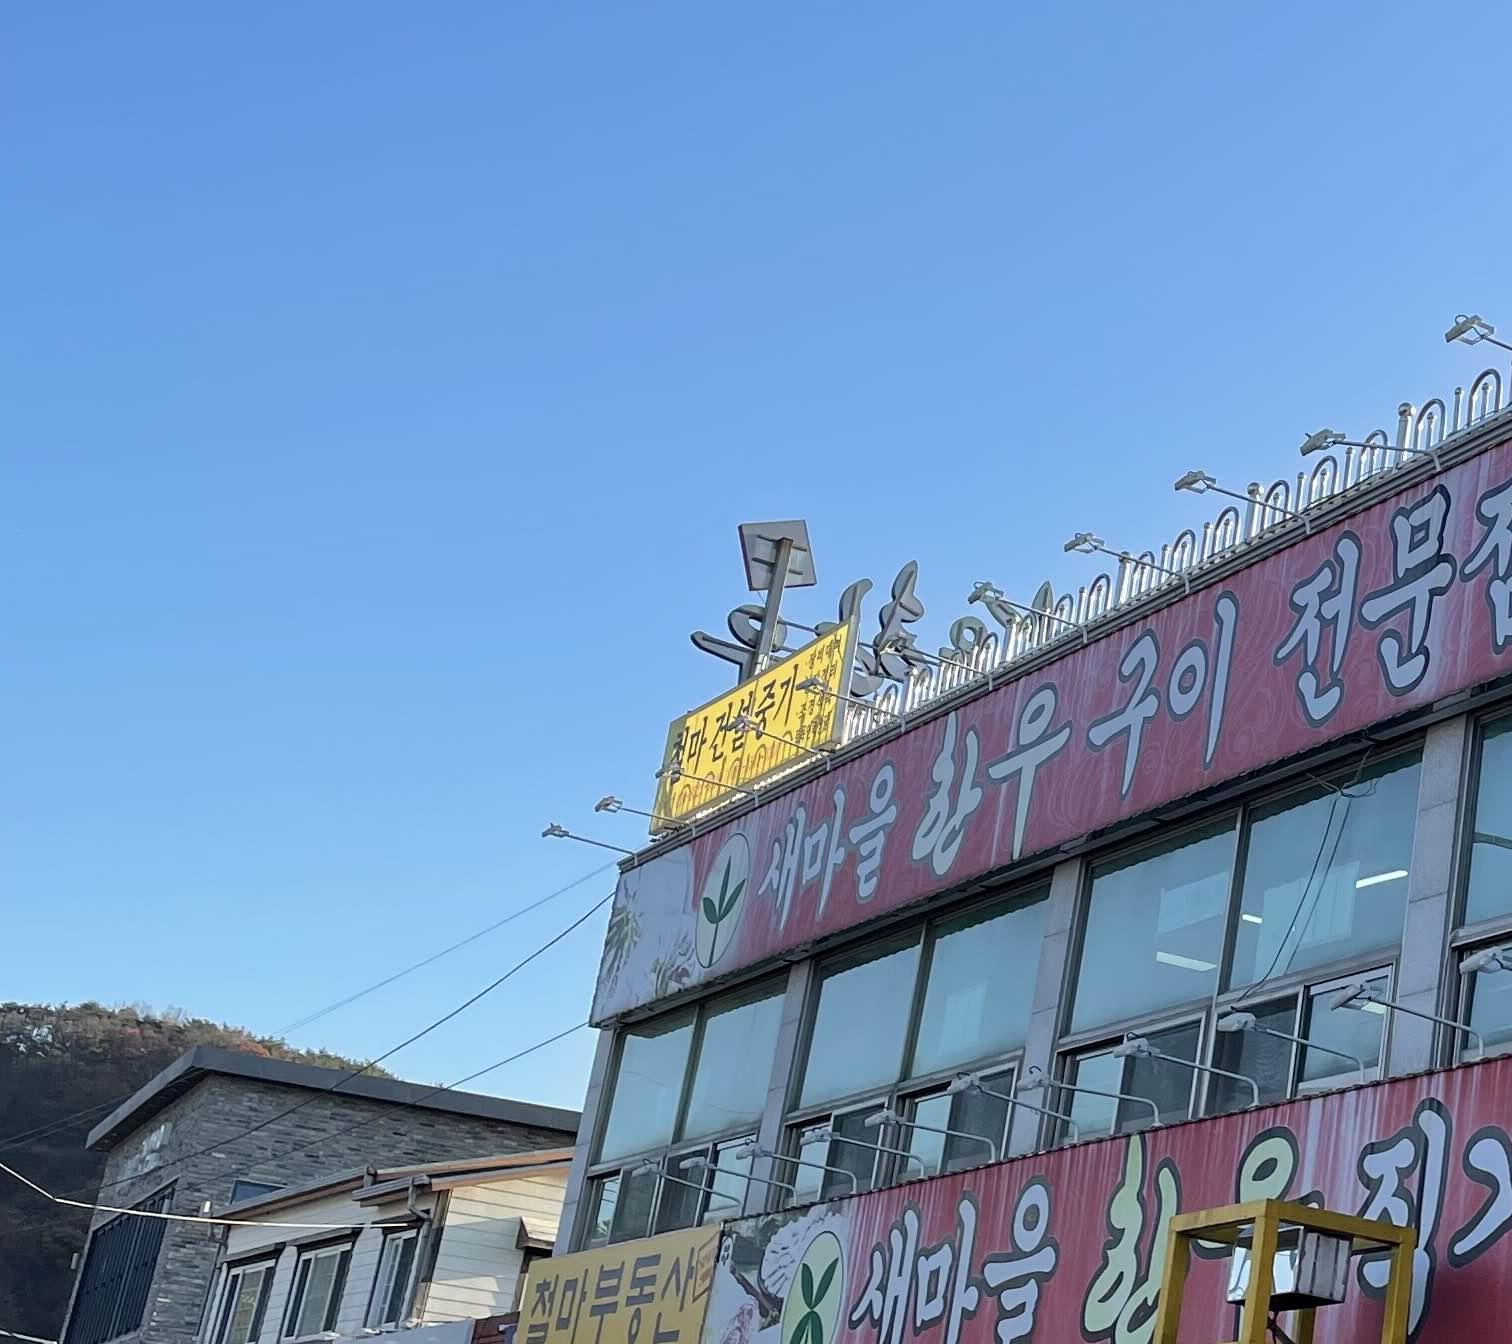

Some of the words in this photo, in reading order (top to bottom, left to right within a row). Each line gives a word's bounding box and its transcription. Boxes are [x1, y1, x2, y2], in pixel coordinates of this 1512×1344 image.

[758, 763, 898, 935] 새마을
[912, 682, 1074, 877] 한우
[1087, 590, 1241, 803] 구이
